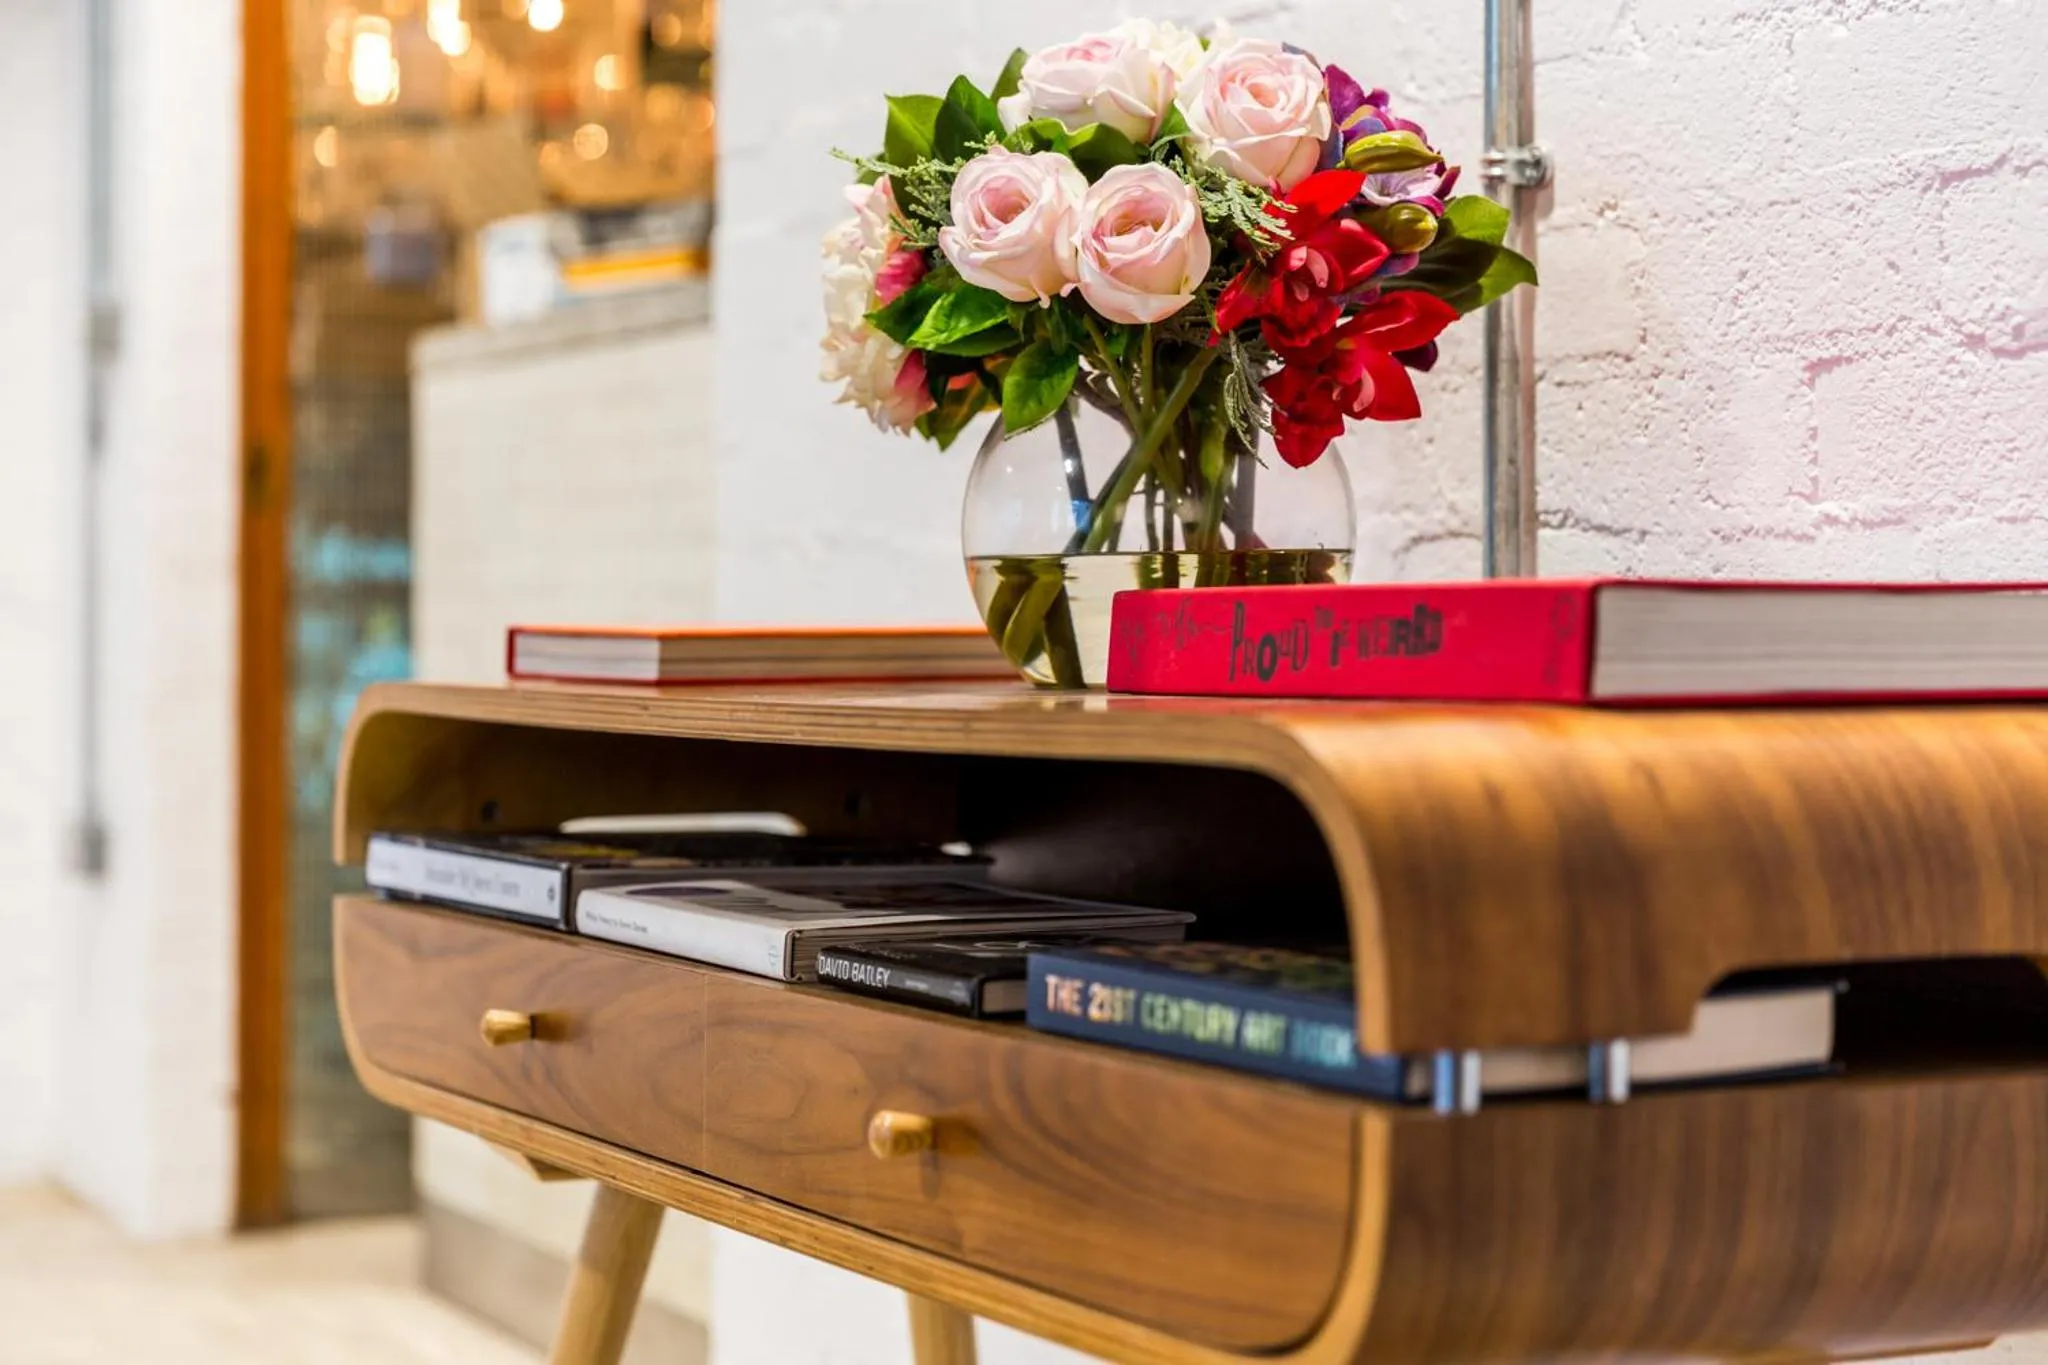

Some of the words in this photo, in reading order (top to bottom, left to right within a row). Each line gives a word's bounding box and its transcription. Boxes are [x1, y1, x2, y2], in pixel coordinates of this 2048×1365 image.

[818, 955, 850, 980] DAVID
[851, 962, 891, 988] BAILEY
[1045, 973, 1084, 1016] THE
[1140, 991, 1240, 1047] CENTURY
